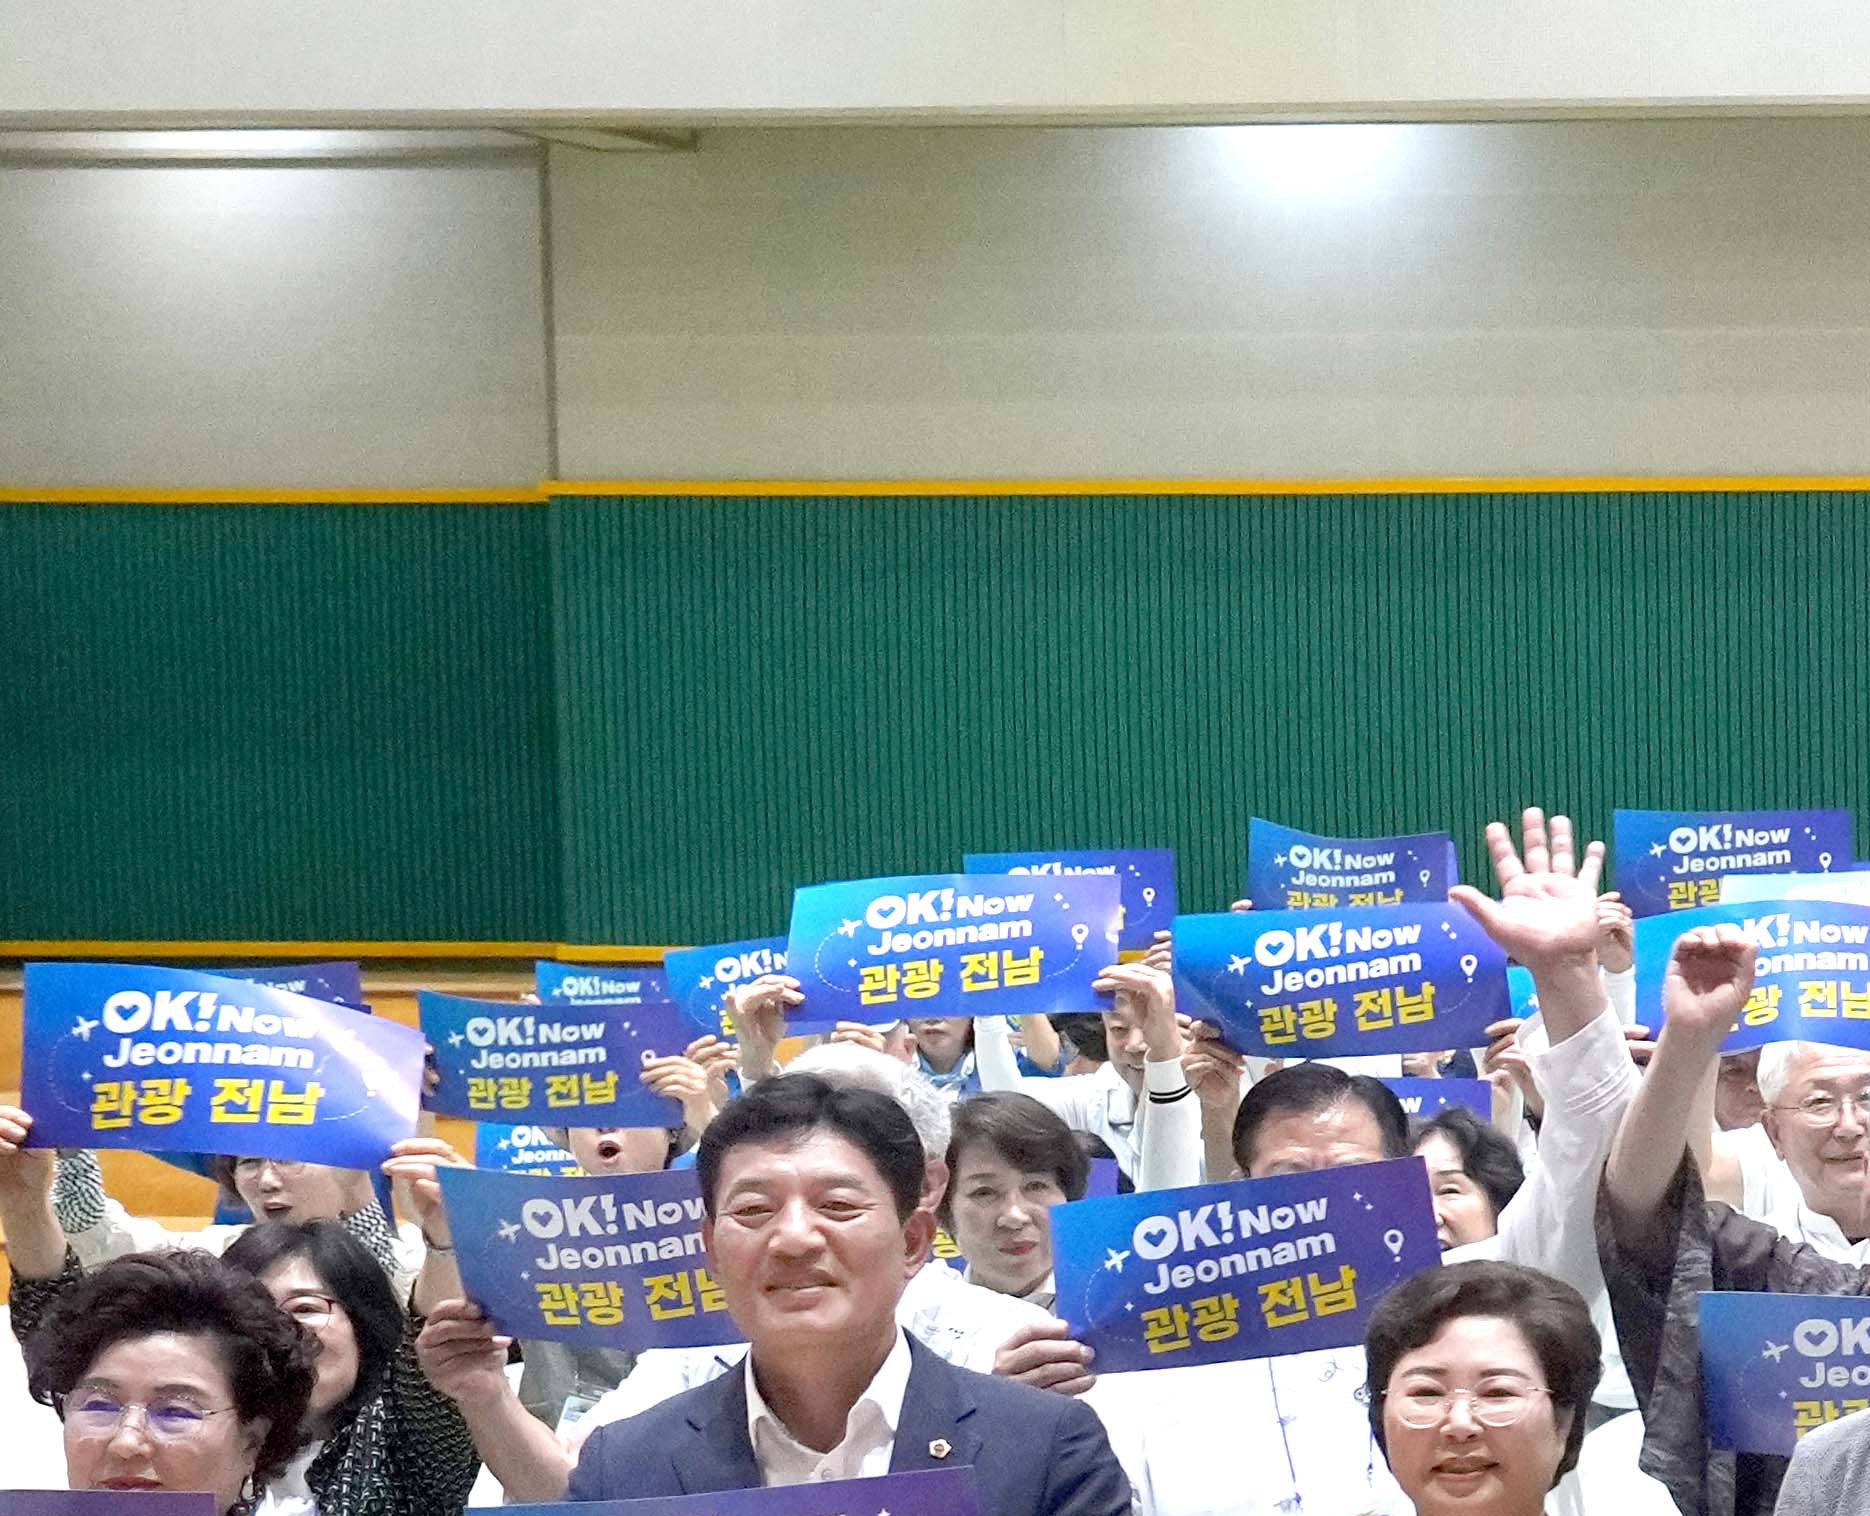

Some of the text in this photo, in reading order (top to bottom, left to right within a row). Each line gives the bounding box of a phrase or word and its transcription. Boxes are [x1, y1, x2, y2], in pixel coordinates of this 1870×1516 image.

[866, 888, 1034, 929] OK! Now
[868, 920, 1032, 955] Jeonnam
[1255, 922, 1421, 966] OK! Now
[860, 947, 1043, 1004] 관광 전남
[1261, 953, 1421, 995] Jeonnam
[104, 991, 220, 1033] OK!
[1259, 982, 1435, 1044] 관광 전남
[103, 1037, 314, 1069] Jeonnam
[92, 1078, 325, 1129] 관광 전남
